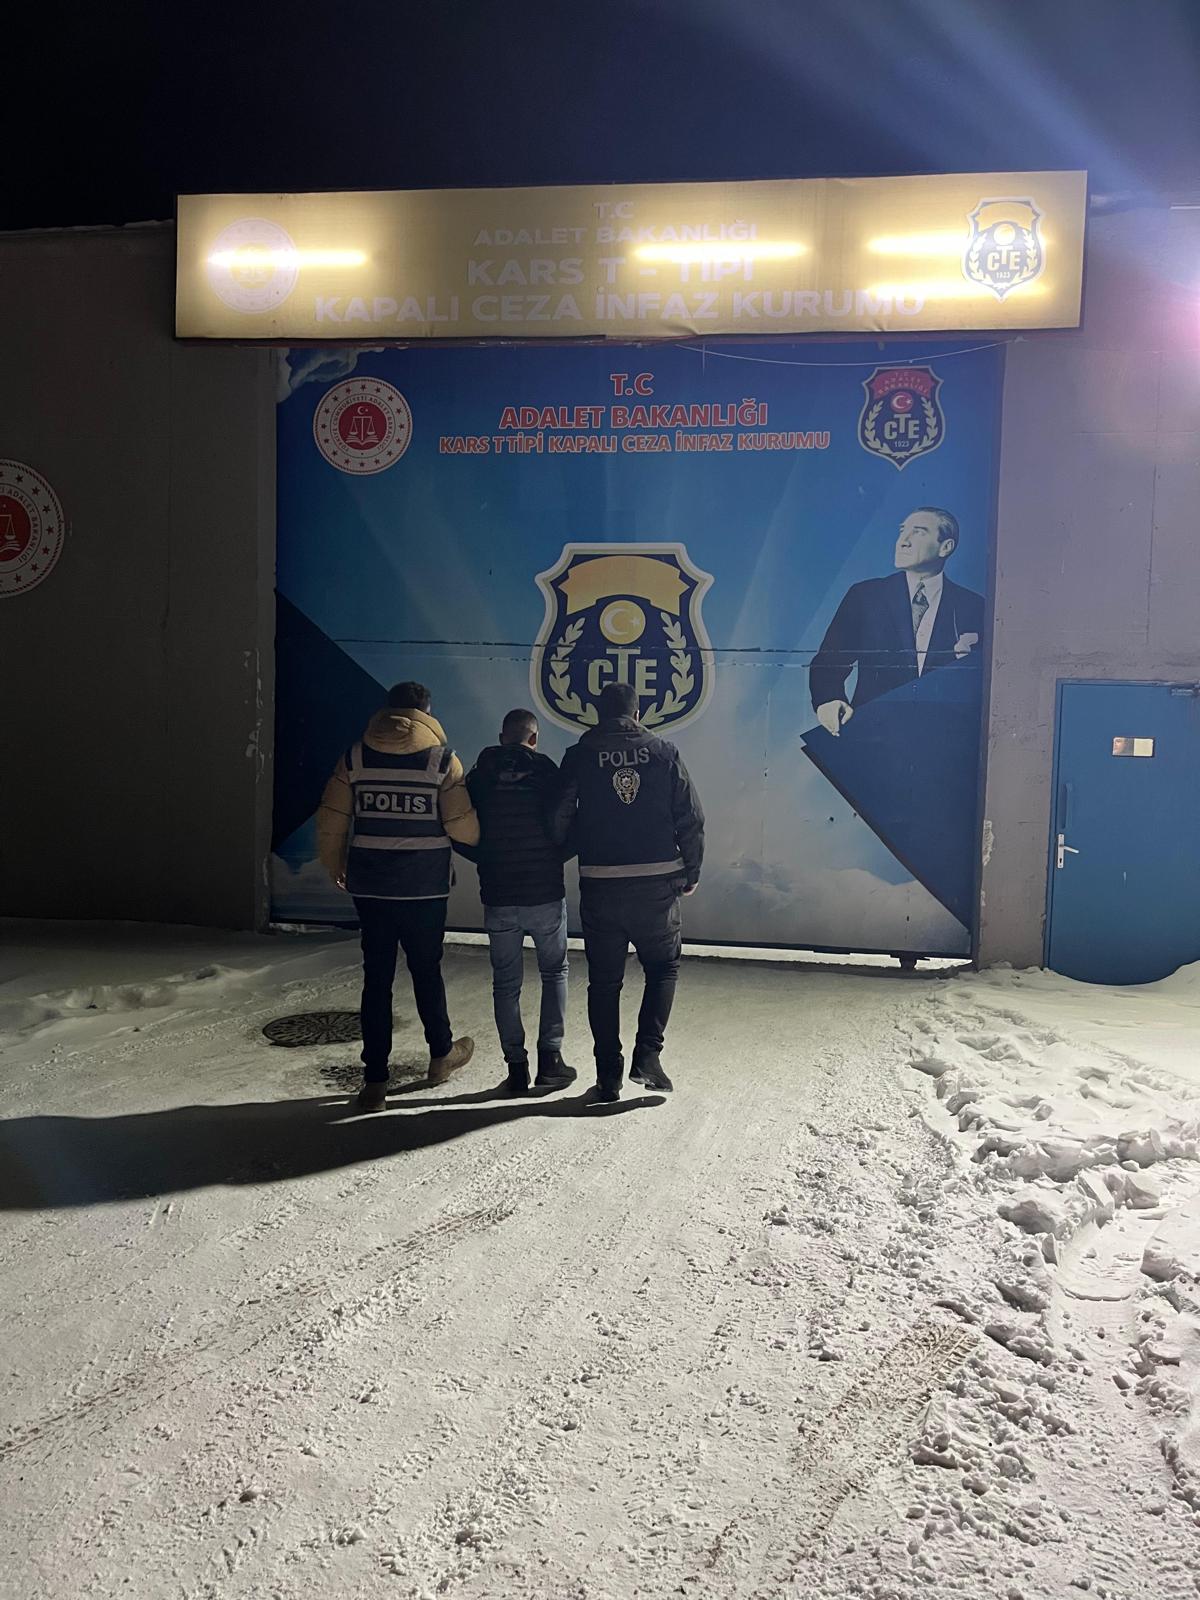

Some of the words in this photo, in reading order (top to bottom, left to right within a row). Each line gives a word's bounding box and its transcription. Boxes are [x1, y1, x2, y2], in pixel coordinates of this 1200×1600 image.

[594, 201, 635, 219] T.C
[473, 227, 588, 247] ADALET
[596, 219, 758, 244] BAKANLIĞI
[468, 258, 584, 286] KARS
[599, 257, 626, 284] T
[987, 245, 1021, 271] CTE
[315, 296, 459, 323] KAPALI
[472, 294, 584, 322] CEZA
[596, 287, 720, 320] İNFAZ
[732, 289, 926, 319] KURUMU
[610, 373, 654, 396] T.C
[499, 406, 605, 429] ADALET
[611, 398, 768, 429] BAKANLIĞI
[884, 413, 920, 440] CTE
[439, 436, 490, 454] KARS
[492, 436, 505, 454] T
[506, 432, 544, 454] TİPİ
[548, 435, 618, 453] KAPALI
[622, 434, 672, 453] CEZA
[675, 430, 734, 452] İNFAZ
[738, 431, 831, 451] KURUMU
[588, 648, 658, 696] CTE
